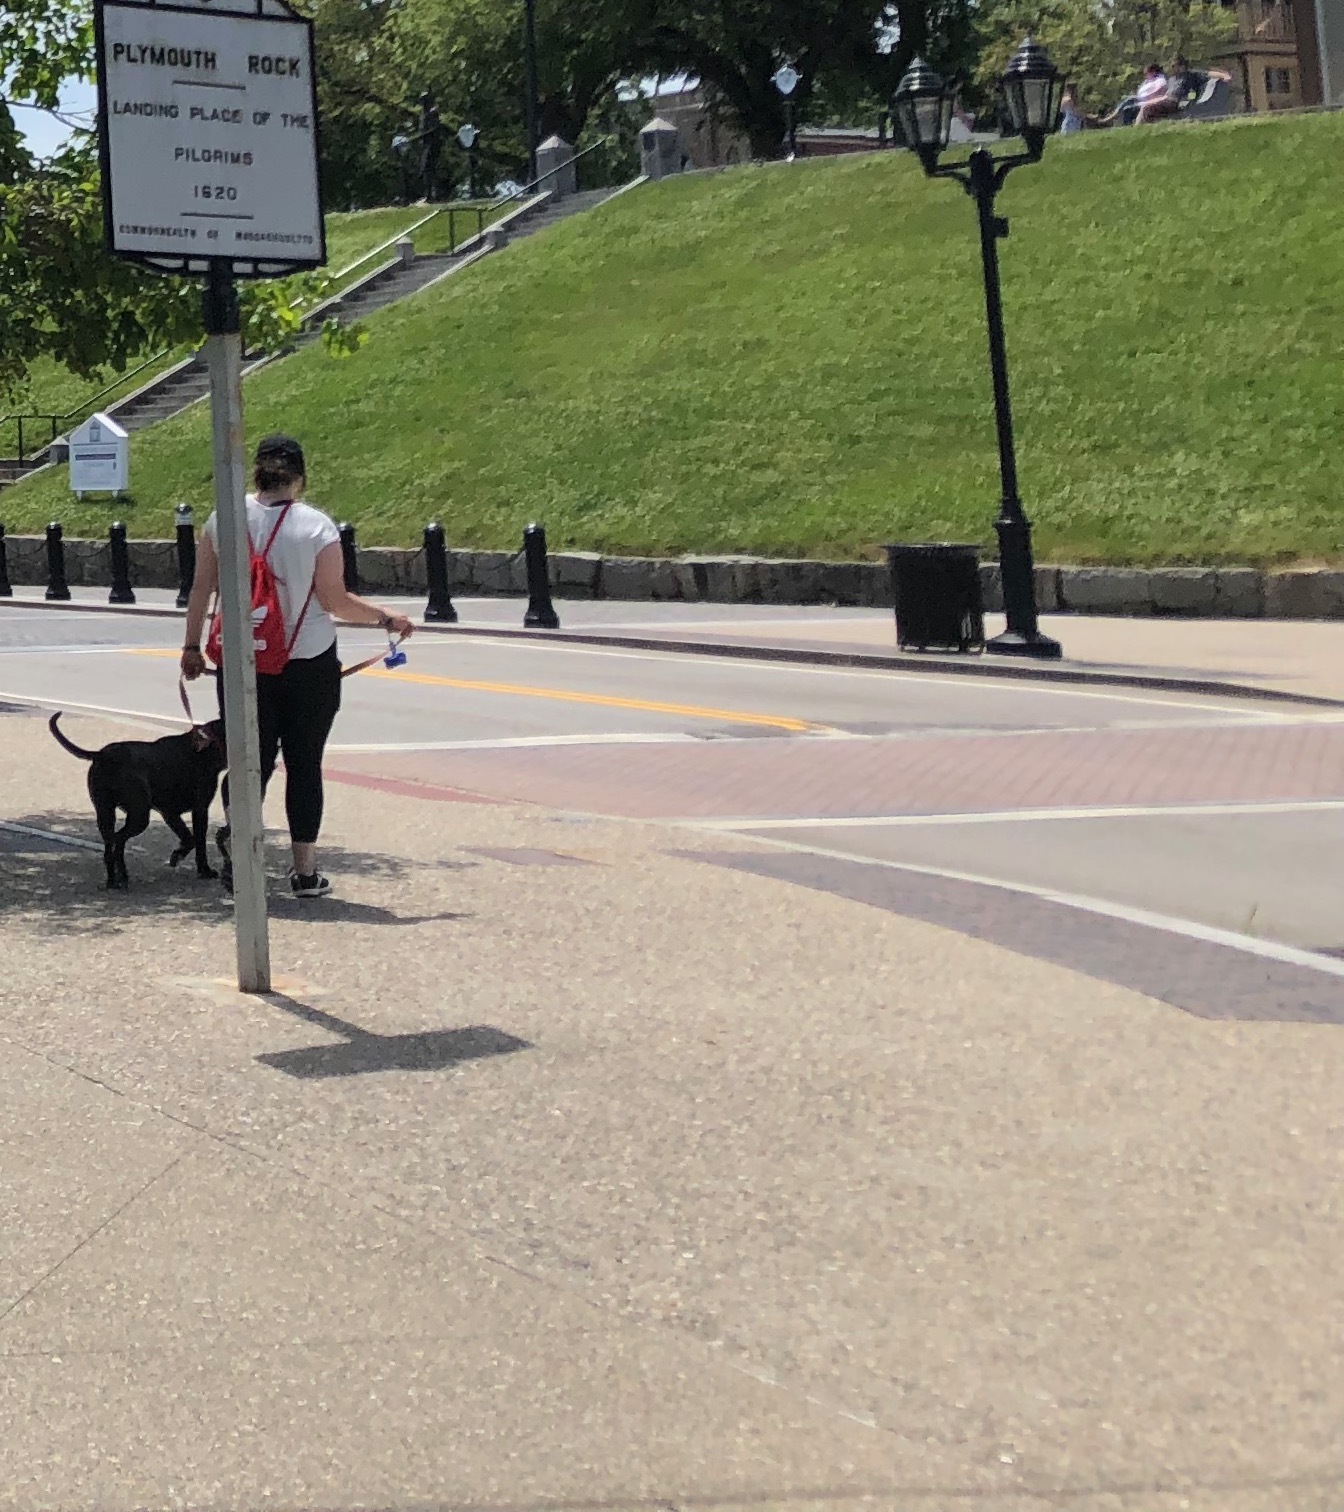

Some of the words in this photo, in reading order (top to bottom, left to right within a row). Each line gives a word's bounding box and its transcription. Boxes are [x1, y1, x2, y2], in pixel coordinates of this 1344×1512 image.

[113, 43, 216, 70] PLYMOUTH
[248, 55, 300, 78] ROCK
[112, 100, 179, 119] LANDING
[189, 106, 243, 124] PLACE
[252, 111, 271, 126] OF
[280, 113, 309, 129] THE
[174, 147, 254, 166] PILGRIMS
[193, 185, 238, 201] 1620
